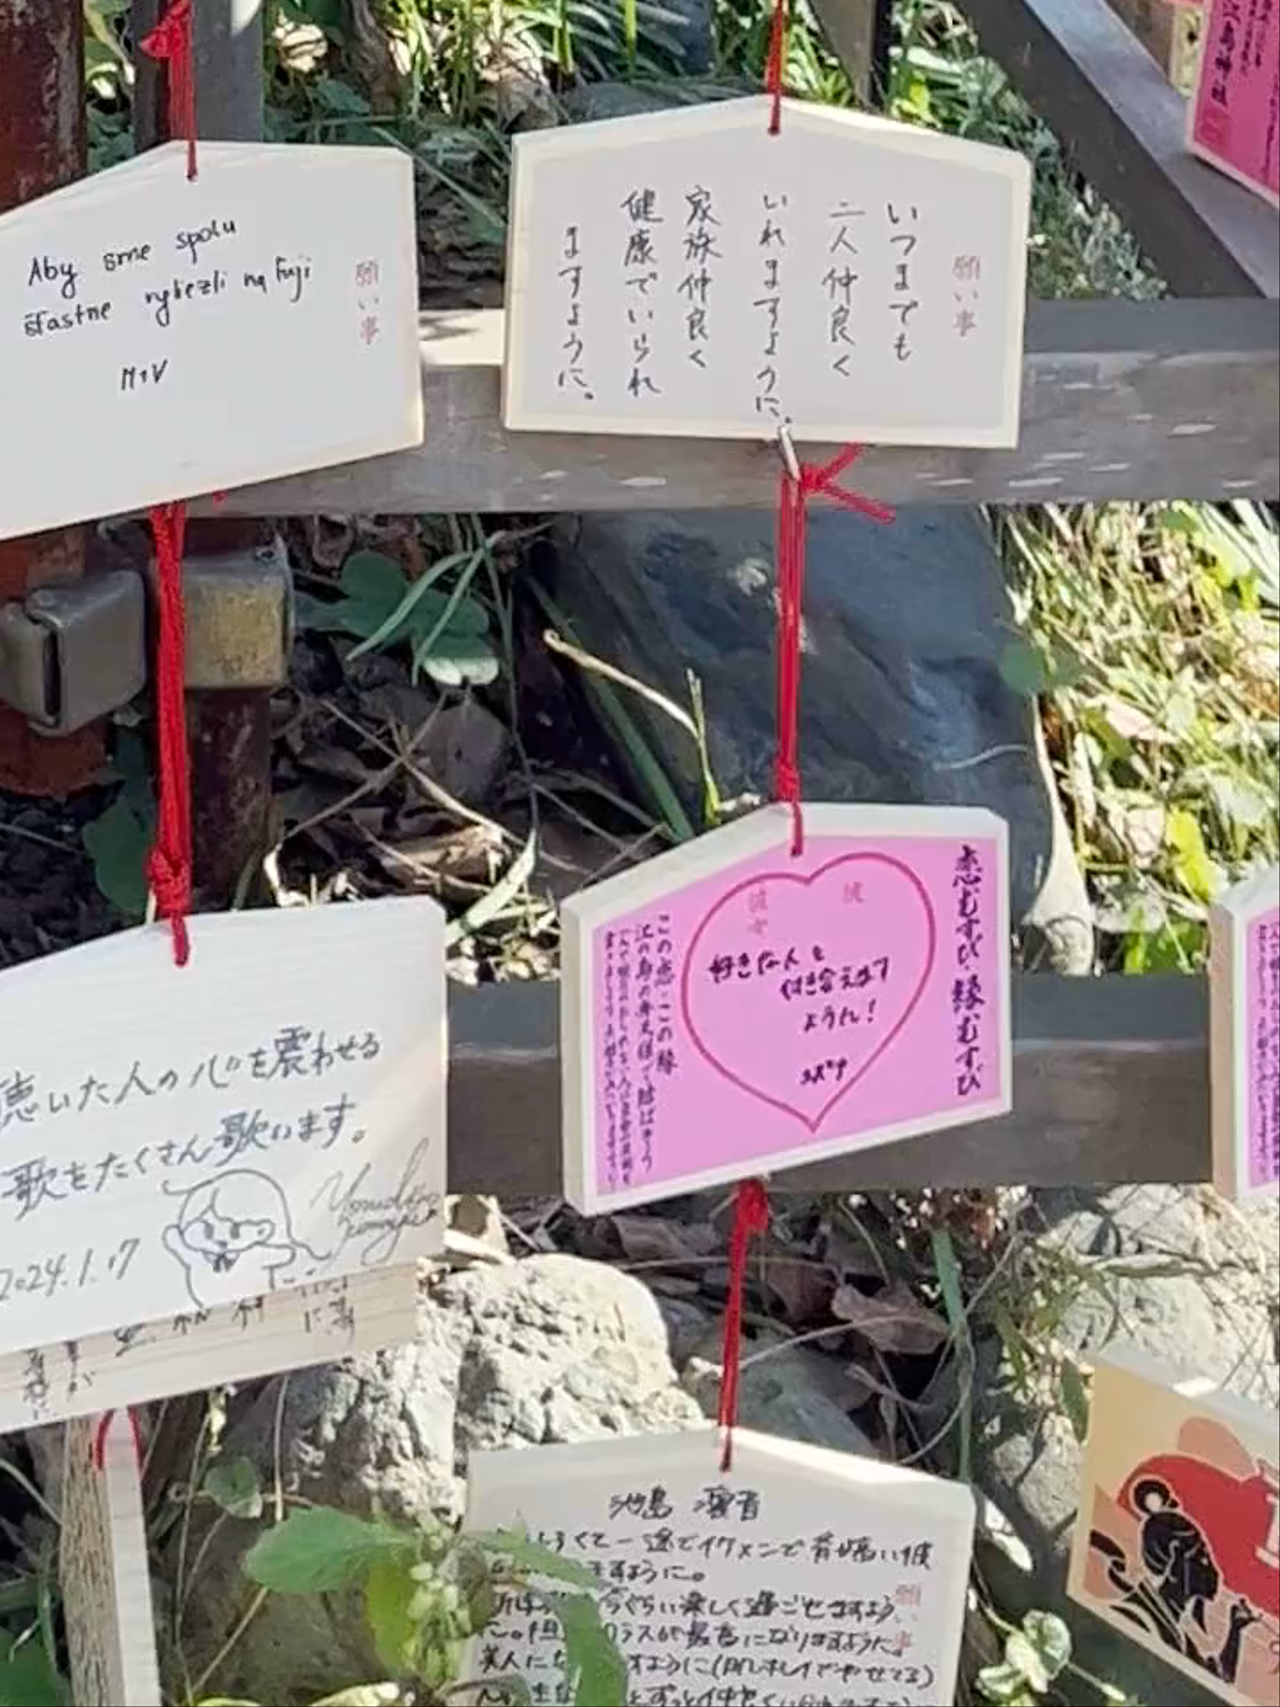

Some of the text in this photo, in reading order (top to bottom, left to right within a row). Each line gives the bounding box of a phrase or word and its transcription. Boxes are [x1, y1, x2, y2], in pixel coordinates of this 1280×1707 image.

[887, 202, 920, 361] いつまでも
